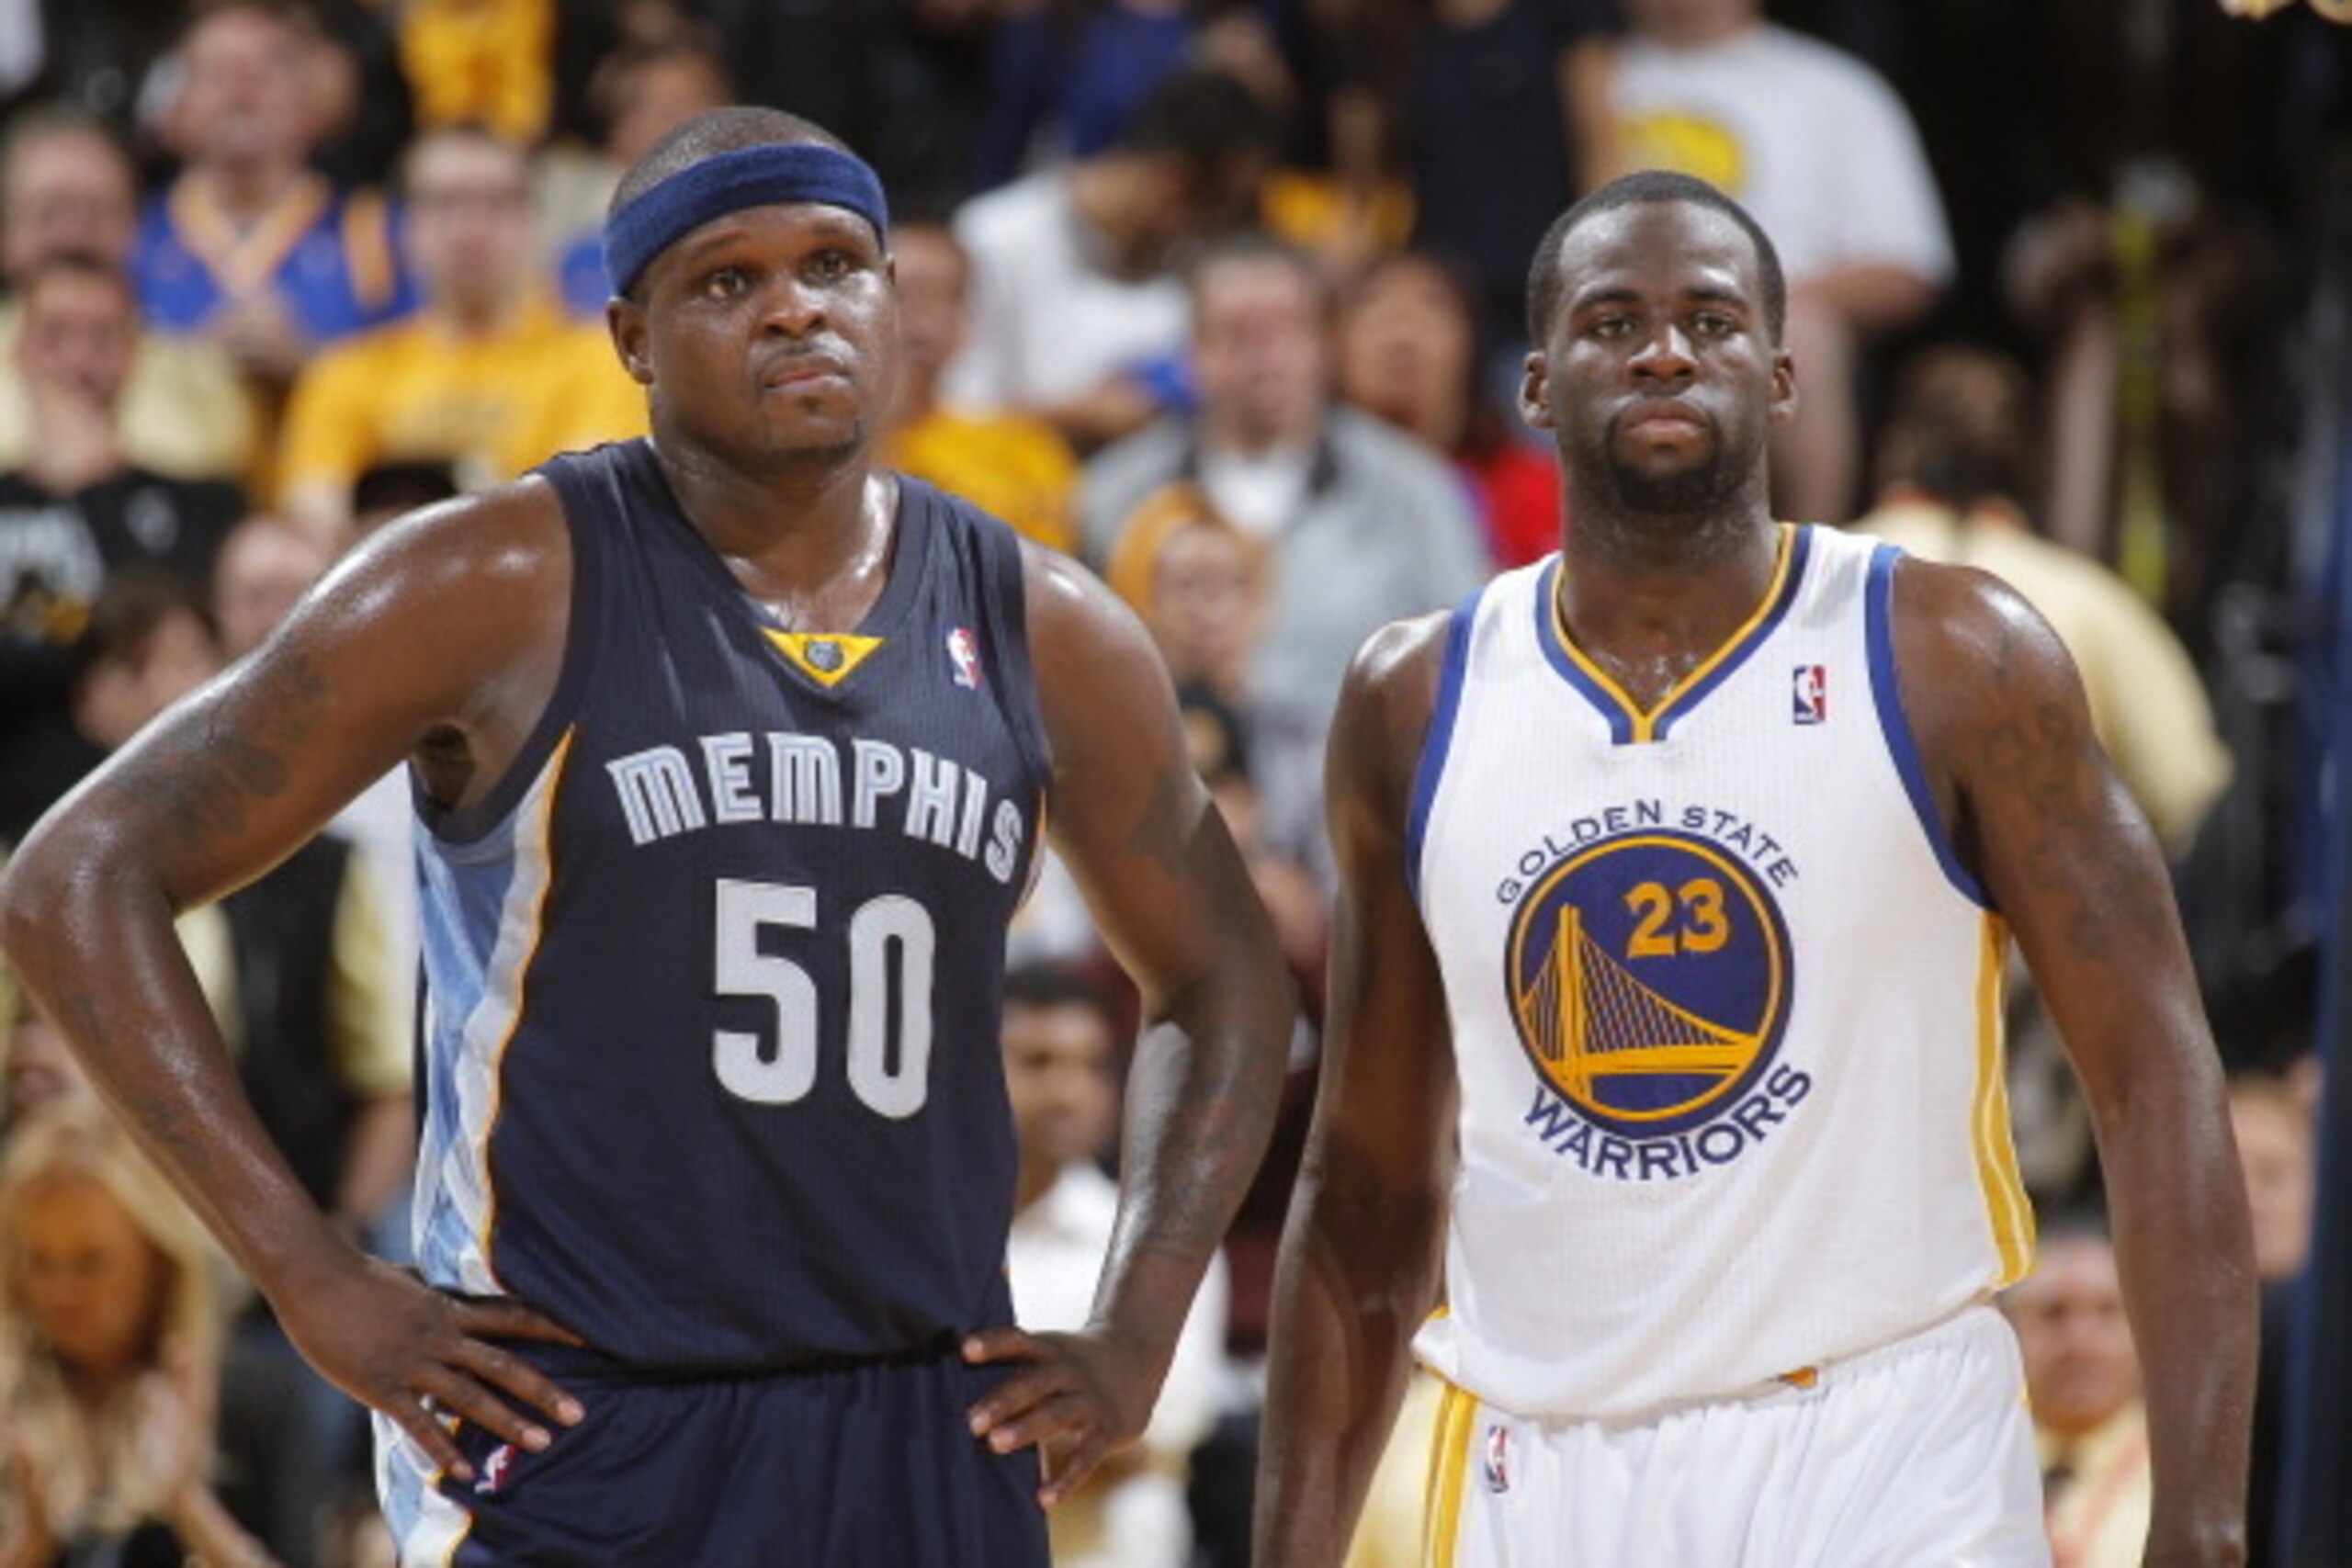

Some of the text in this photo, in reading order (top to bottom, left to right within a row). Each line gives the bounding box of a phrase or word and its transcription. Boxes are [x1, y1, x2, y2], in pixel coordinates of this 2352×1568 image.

[604, 731, 1023, 884] MEMPHIS
[1496, 799, 1799, 905] GOLDEN STATE
[1623, 877, 1731, 960] 23
[712, 877, 935, 1121] 50
[1522, 1063, 1813, 1181] WARRIORS
